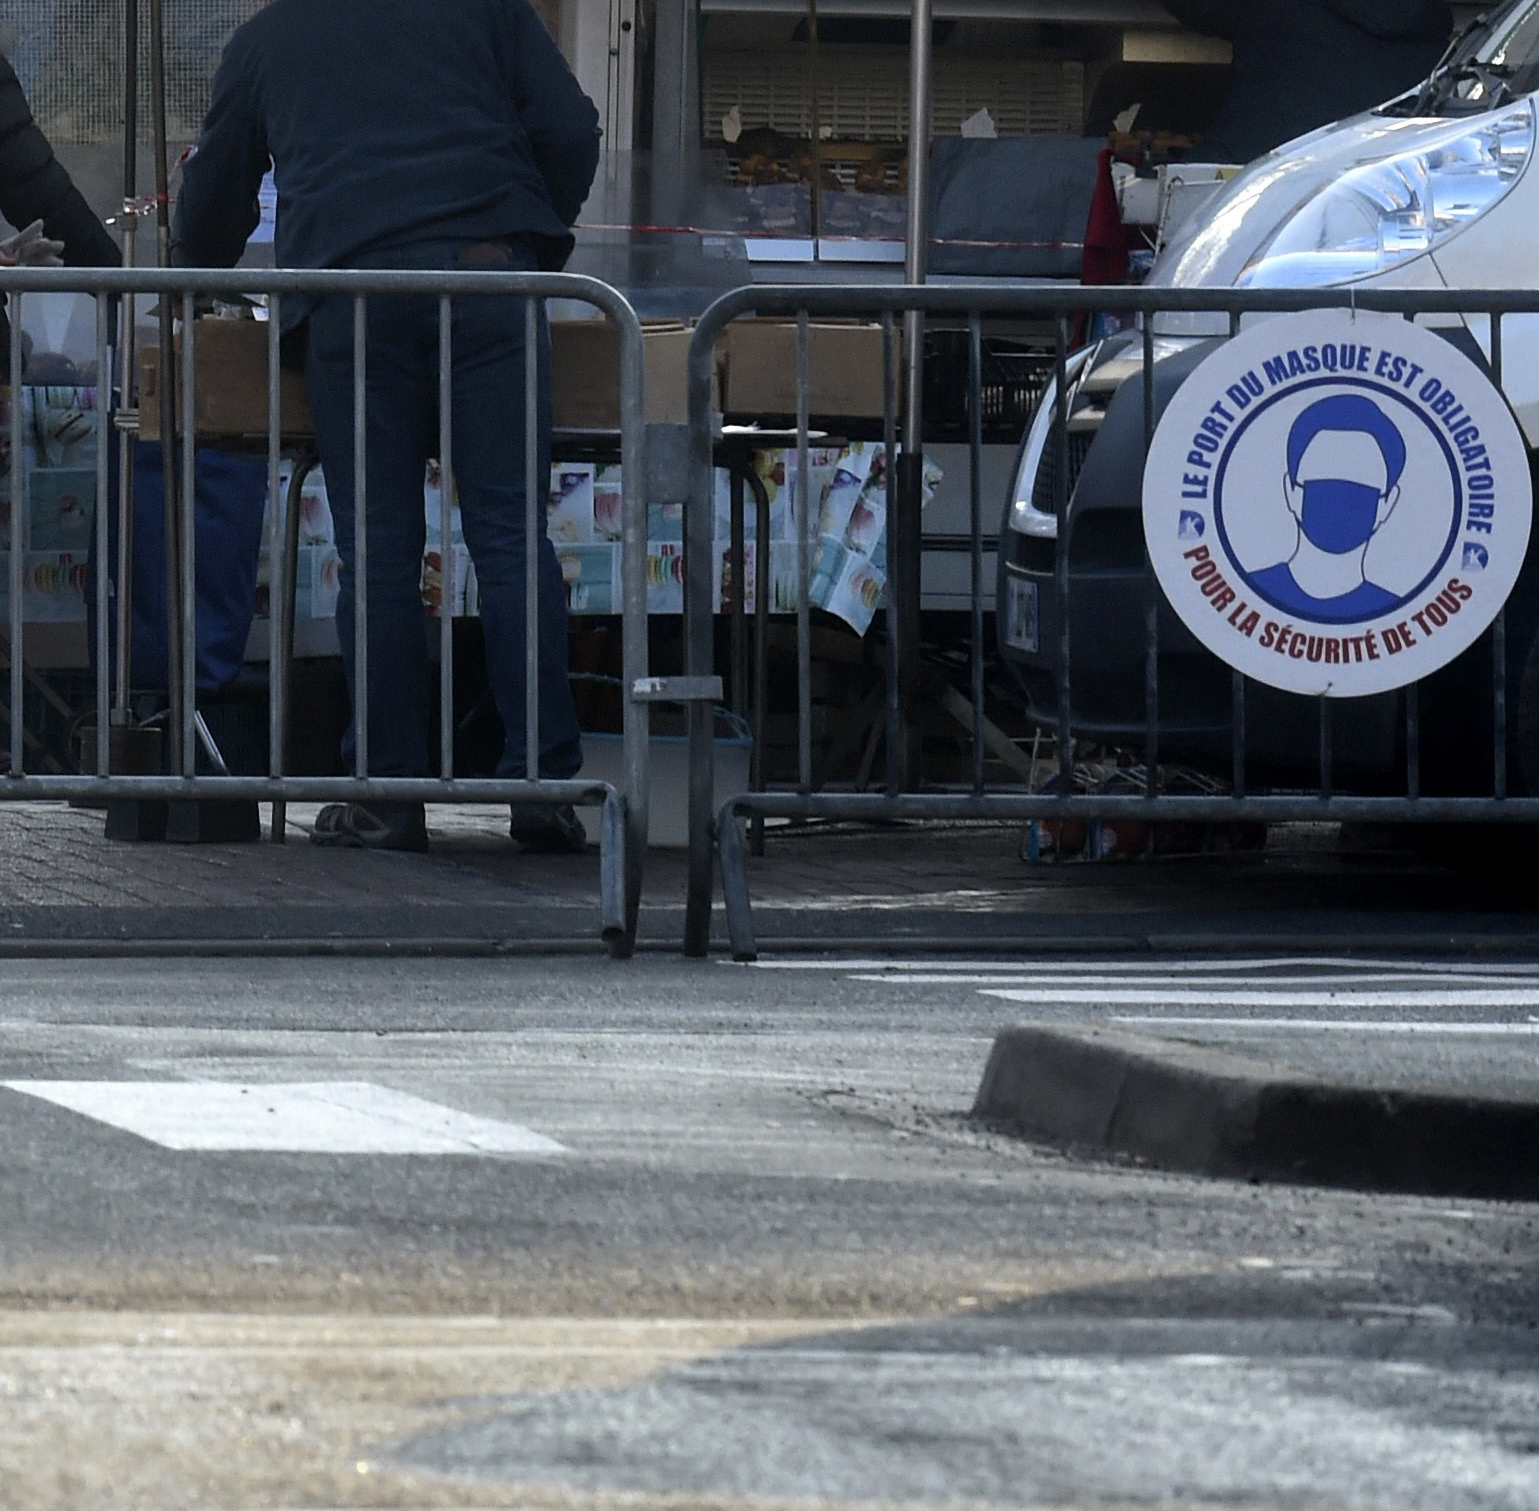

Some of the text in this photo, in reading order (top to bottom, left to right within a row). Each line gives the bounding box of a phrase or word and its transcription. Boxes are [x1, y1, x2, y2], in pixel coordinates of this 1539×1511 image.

[1181, 343, 1495, 535] LE PORT DU MASQUE EST OBLIGATOIRE
[1183, 544, 1473, 664] POUR LA SÉCURITÉ DE TOUS
